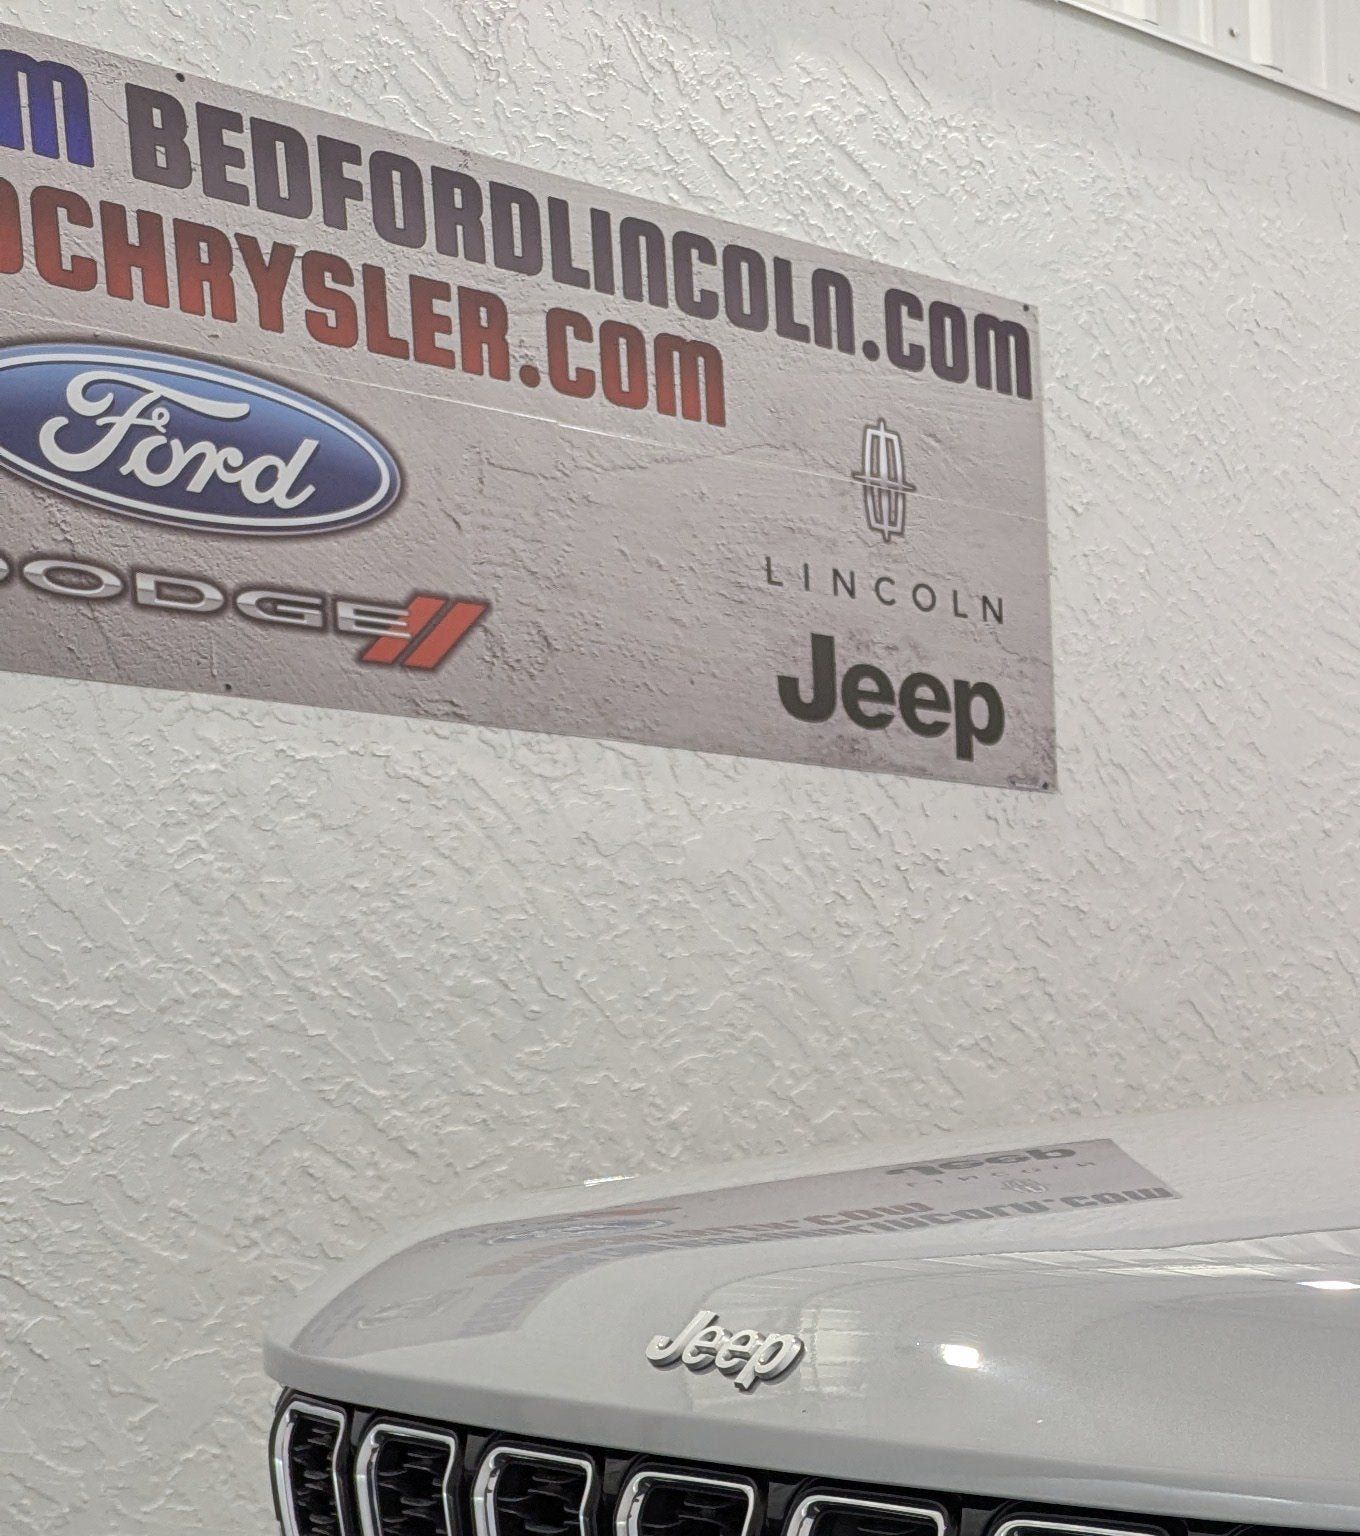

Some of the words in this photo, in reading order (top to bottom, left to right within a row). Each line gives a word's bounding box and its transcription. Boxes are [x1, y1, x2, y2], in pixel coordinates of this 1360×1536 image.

[125, 82, 1034, 400] BEDFORDLINCOLN.COM
[39, 366, 318, 512] Ford
[0, 555, 412, 640] ODGE
[764, 555, 1004, 625] LINCOLN
[776, 632, 1005, 761] Jeep
[645, 1309, 805, 1391] Jeep
